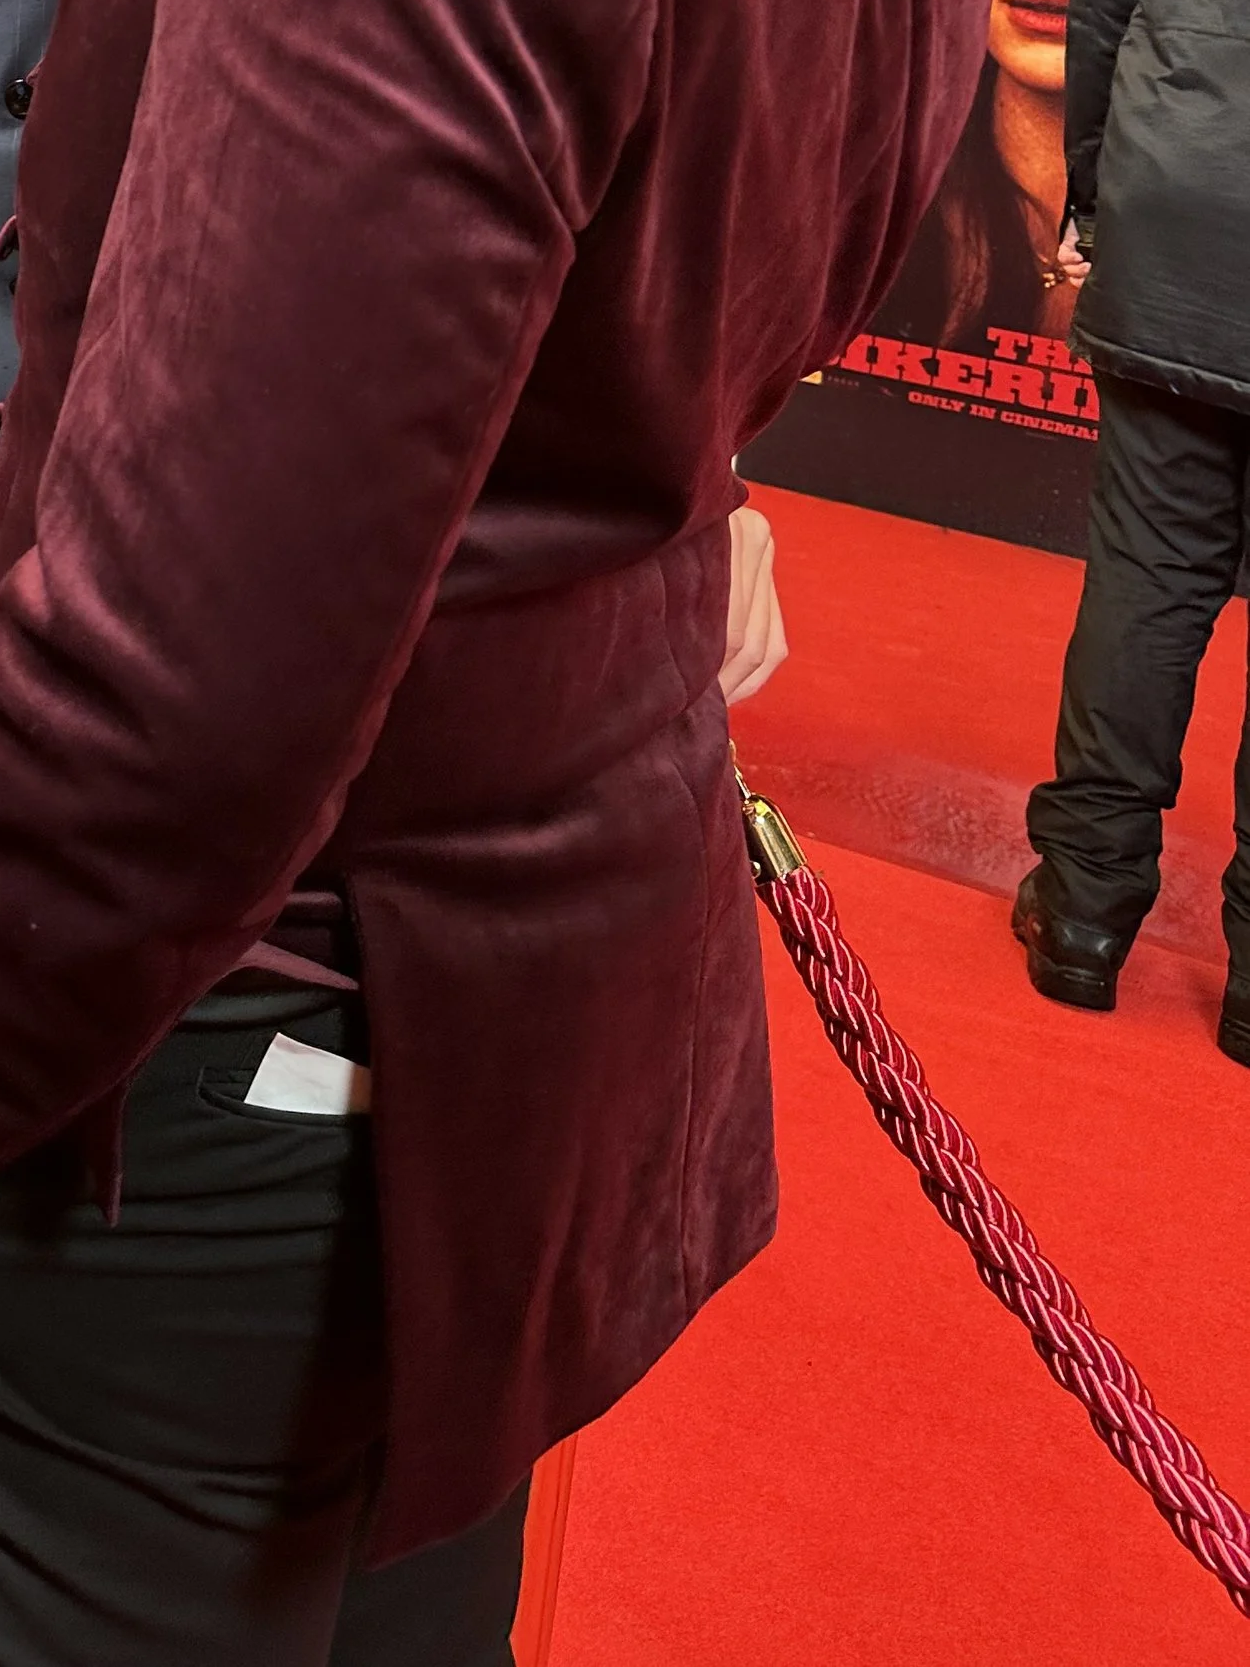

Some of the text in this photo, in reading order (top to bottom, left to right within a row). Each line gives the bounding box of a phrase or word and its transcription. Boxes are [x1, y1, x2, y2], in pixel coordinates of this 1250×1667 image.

[987, 327, 1093, 375] TH
[908, 390, 965, 413] ONLY
[969, 404, 997, 420] IN
